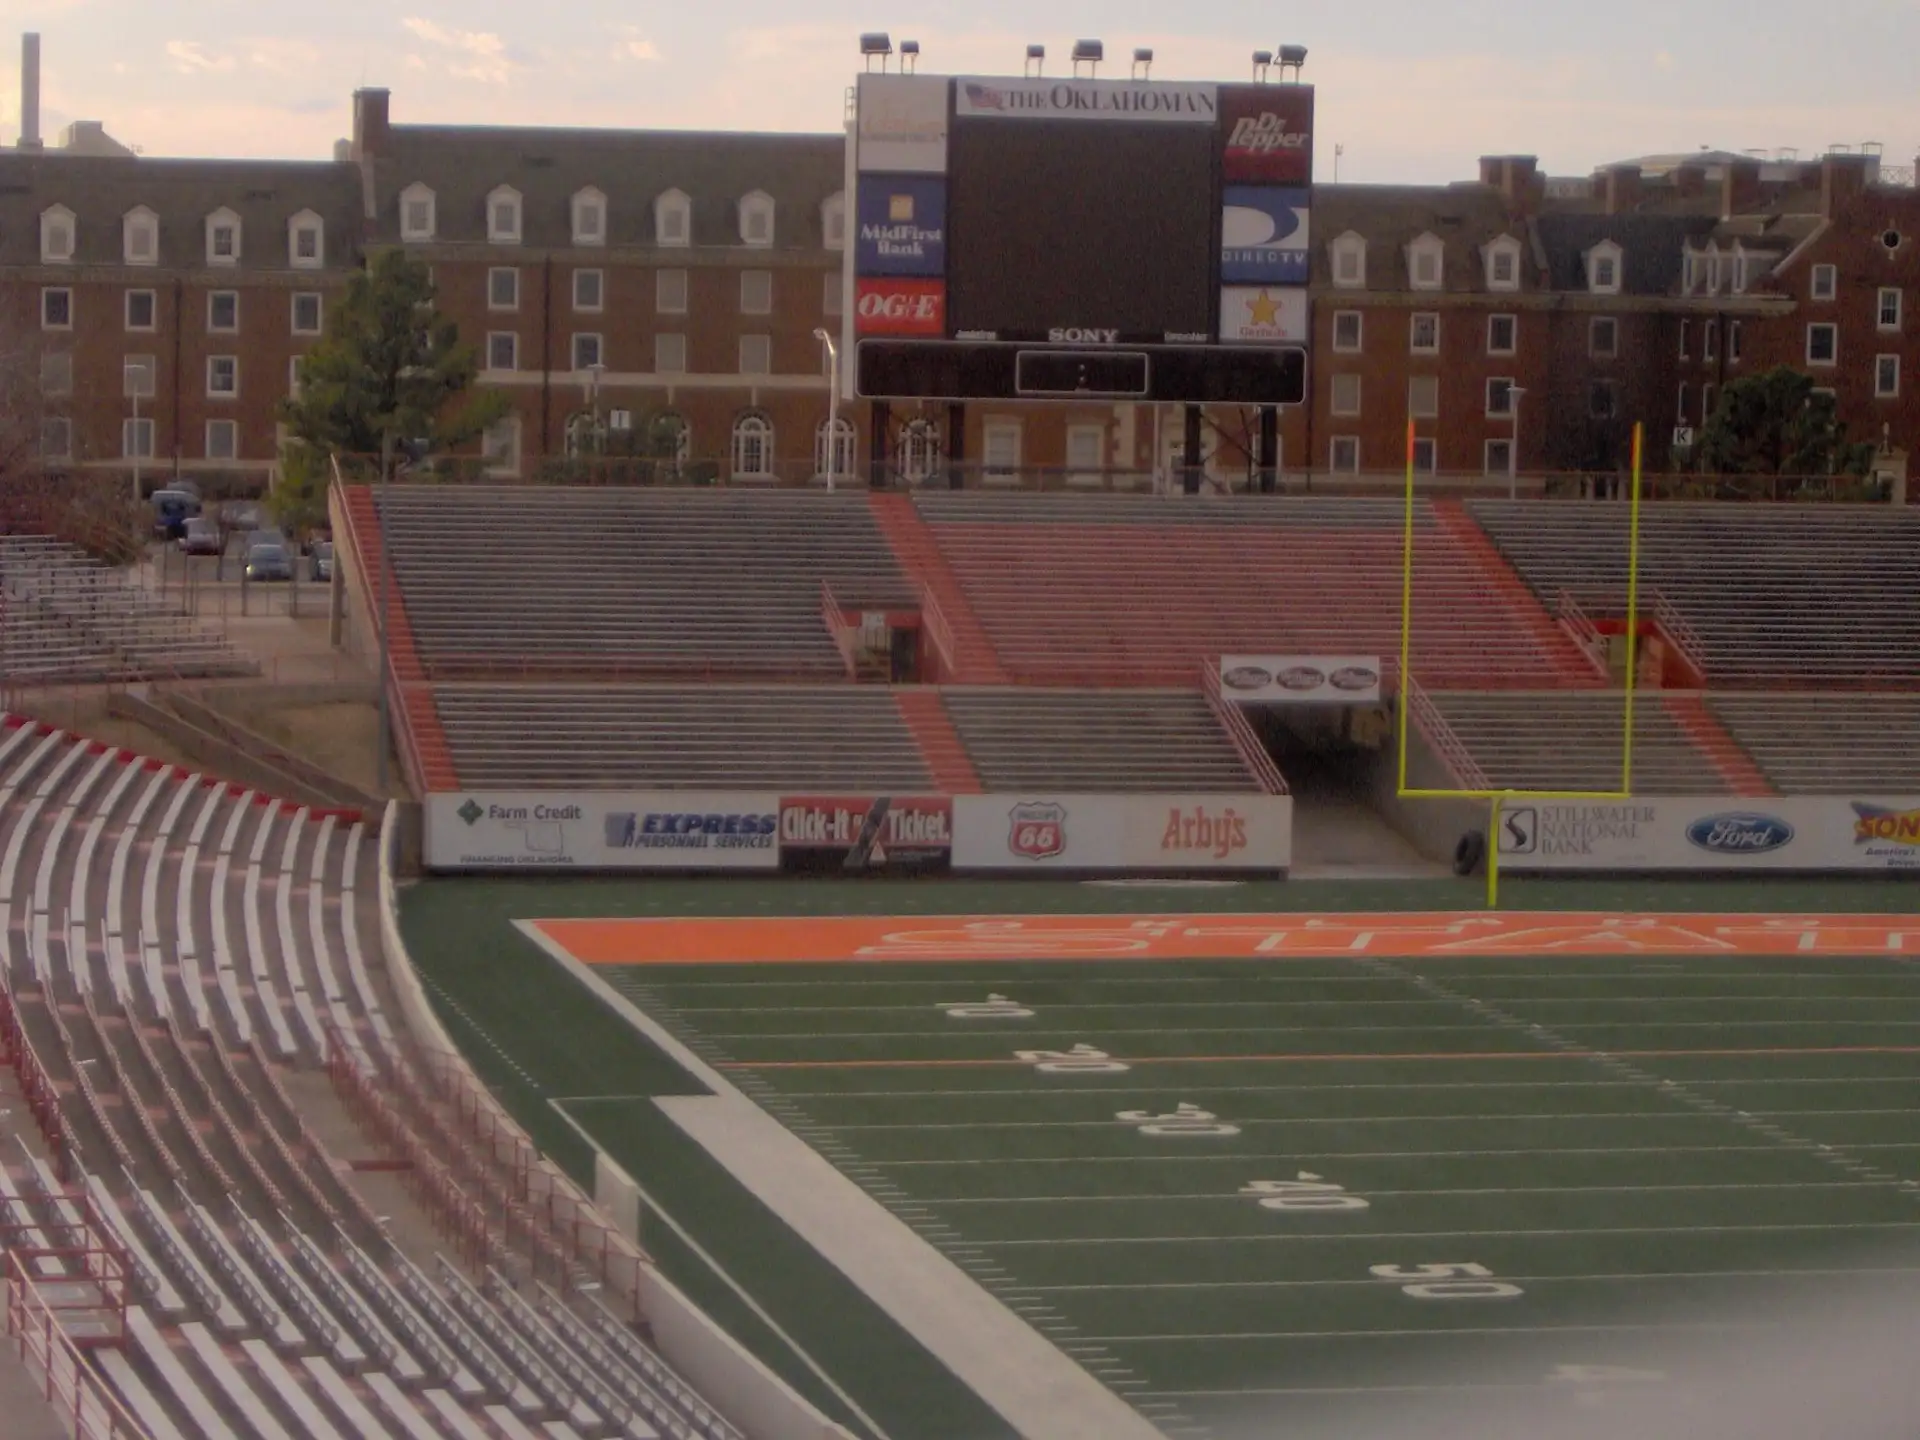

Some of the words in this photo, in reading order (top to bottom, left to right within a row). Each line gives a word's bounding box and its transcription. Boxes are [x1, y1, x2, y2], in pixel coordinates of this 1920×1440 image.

[1008, 91, 1047, 109] THE
[1050, 85, 1215, 113] OKLAHOMAN
[1257, 111, 1286, 132] Dr
[1228, 117, 1310, 152] Pepper
[861, 224, 942, 240] MidFirst
[877, 240, 924, 255] Bank
[1221, 251, 1305, 263] DIRECTV
[1048, 328, 1118, 342] SONY
[1677, 429, 1687, 442] K
[488, 805, 527, 818] Farm
[534, 805, 581, 819] Credit
[1541, 806, 1655, 822] STILLWATER
[642, 813, 776, 834] EXPRESS
[1541, 822, 1641, 840] NATIONAL
[635, 834, 708, 848] PERSONNEL
[713, 834, 773, 848] SERVICES
[1018, 826, 1055, 849] 66
[1161, 806, 1247, 859] Arby's
[1706, 820, 1772, 847] Ford
[1541, 838, 1593, 855] BANK
